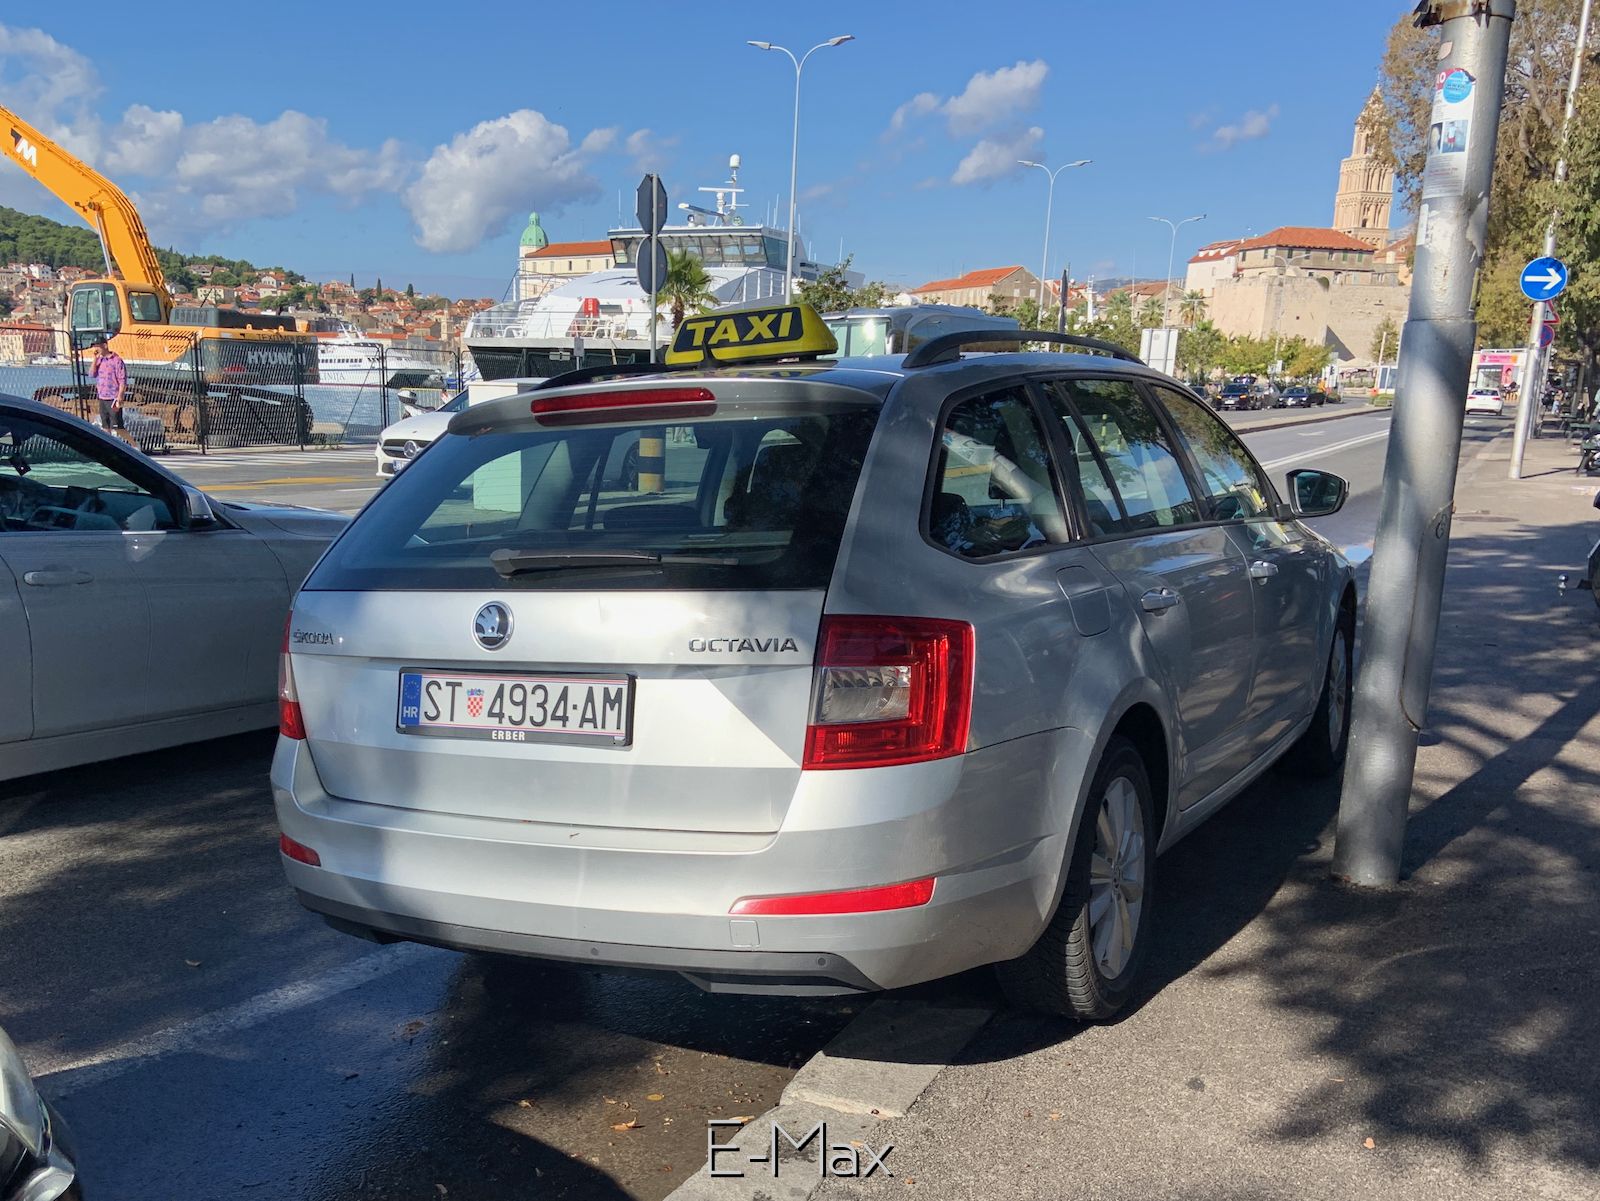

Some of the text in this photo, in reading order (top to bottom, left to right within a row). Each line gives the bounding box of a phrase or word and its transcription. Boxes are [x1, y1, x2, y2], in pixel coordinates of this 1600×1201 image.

[686, 311, 793, 347] TAXI
[688, 637, 799, 653] OCTAVIA
[424, 680, 463, 722] ST
[403, 706, 418, 718] HR
[491, 730, 525, 741] ERBER
